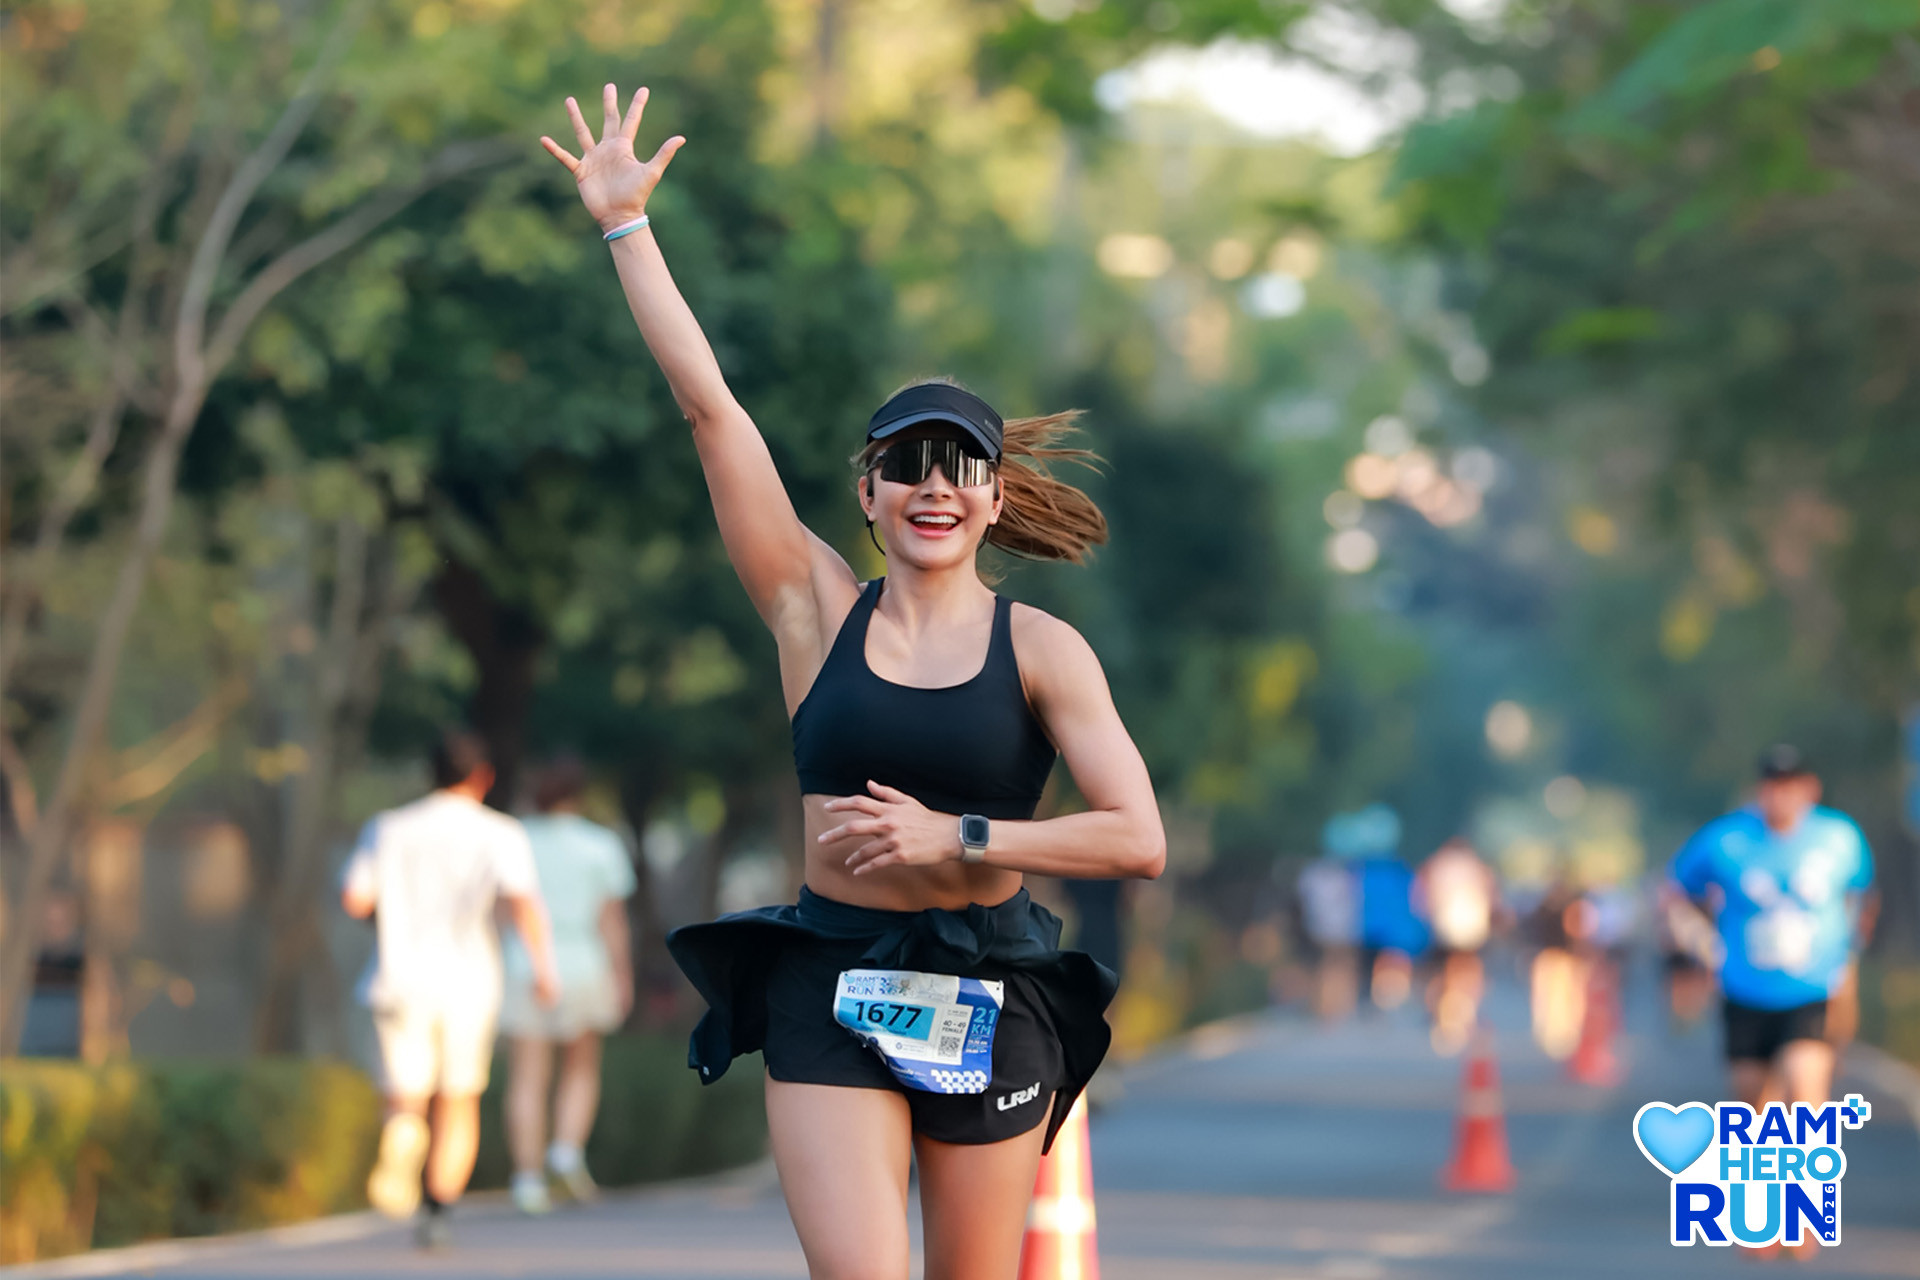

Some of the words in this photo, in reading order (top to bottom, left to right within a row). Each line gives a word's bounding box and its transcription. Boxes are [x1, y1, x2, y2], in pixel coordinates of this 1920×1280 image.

[847, 985, 873, 995] RUN
[855, 1001, 922, 1029] 1677
[974, 1006, 997, 1025] 21
[941, 1026, 964, 1034] FEMALE
[971, 1024, 992, 1036] KM
[997, 1081, 1041, 1111] LRN
